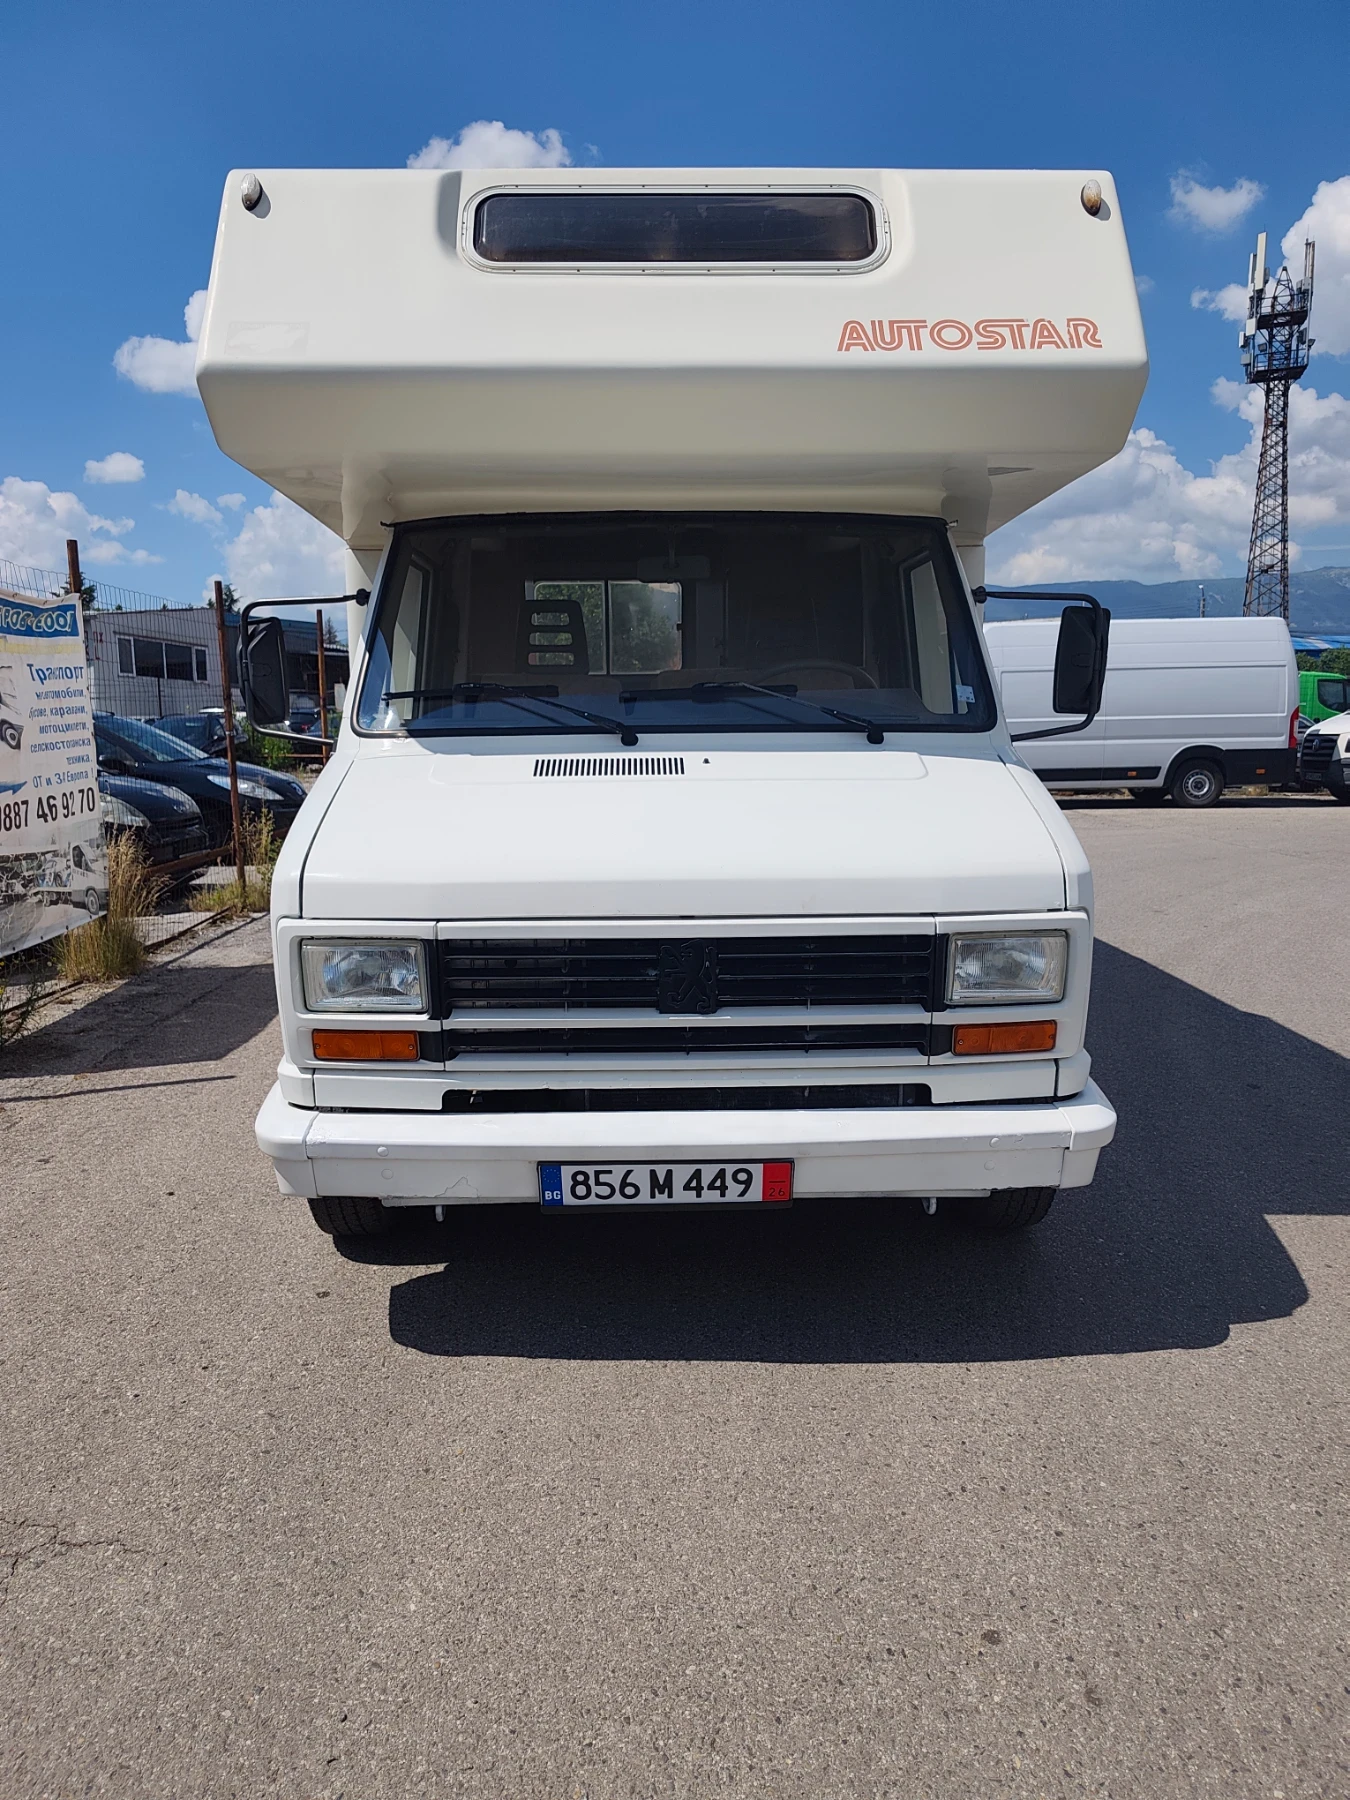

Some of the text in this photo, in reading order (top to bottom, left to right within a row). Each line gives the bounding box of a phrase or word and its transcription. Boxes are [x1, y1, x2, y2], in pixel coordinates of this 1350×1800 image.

[837, 318, 1103, 352] AUTOSTAR
[0, 799, 29, 832] 887
[36, 795, 58, 823] 46
[544, 1167, 786, 1200] BG 856 M 449 26
